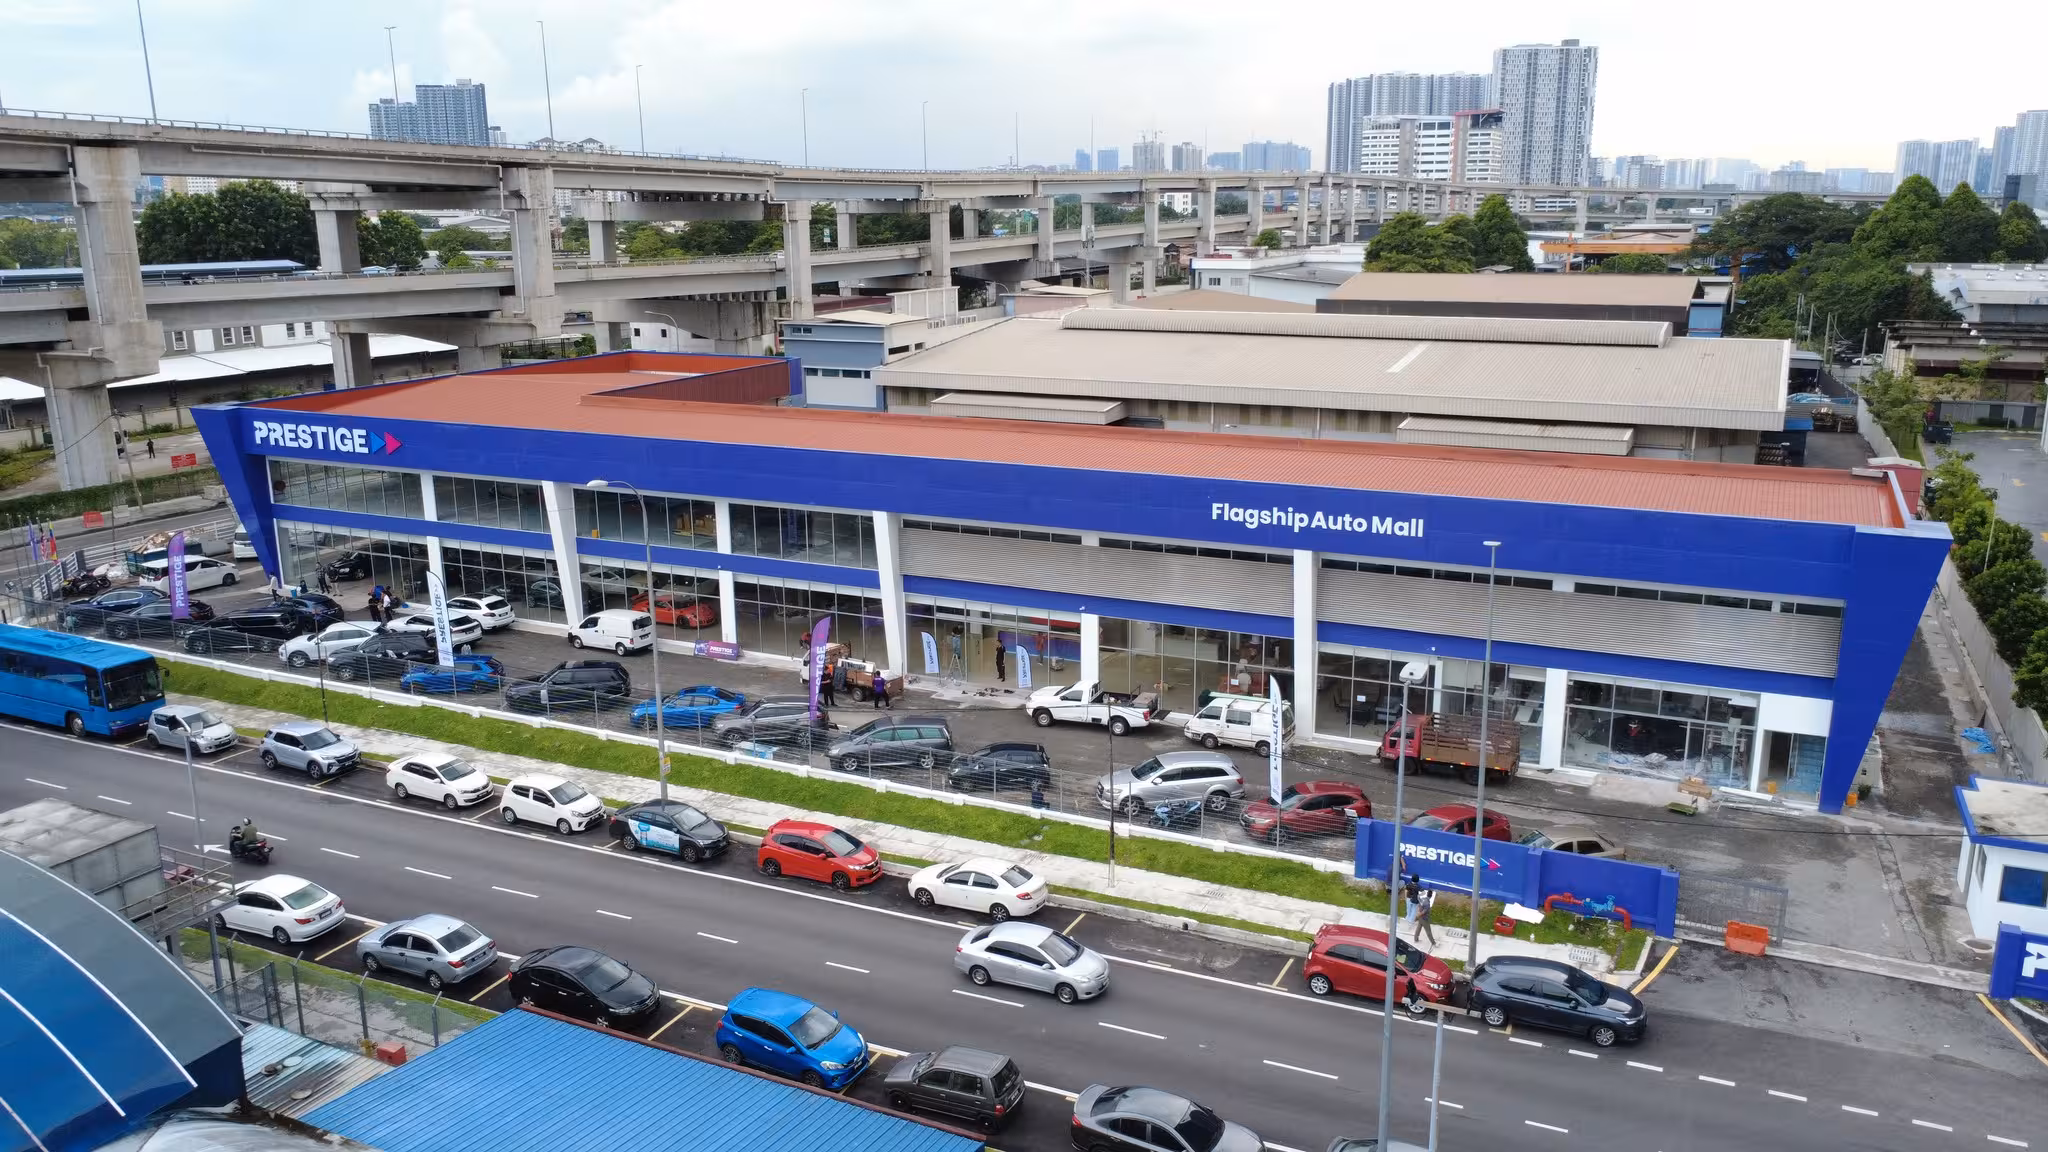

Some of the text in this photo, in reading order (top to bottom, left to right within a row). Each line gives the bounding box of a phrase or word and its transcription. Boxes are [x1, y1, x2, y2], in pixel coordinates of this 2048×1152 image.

[253, 421, 369, 454] PRESTIGE
[1211, 502, 1424, 538] Flagship Auto Mall
[173, 554, 185, 608] PRESTIGE
[815, 645, 826, 702] STIGE
